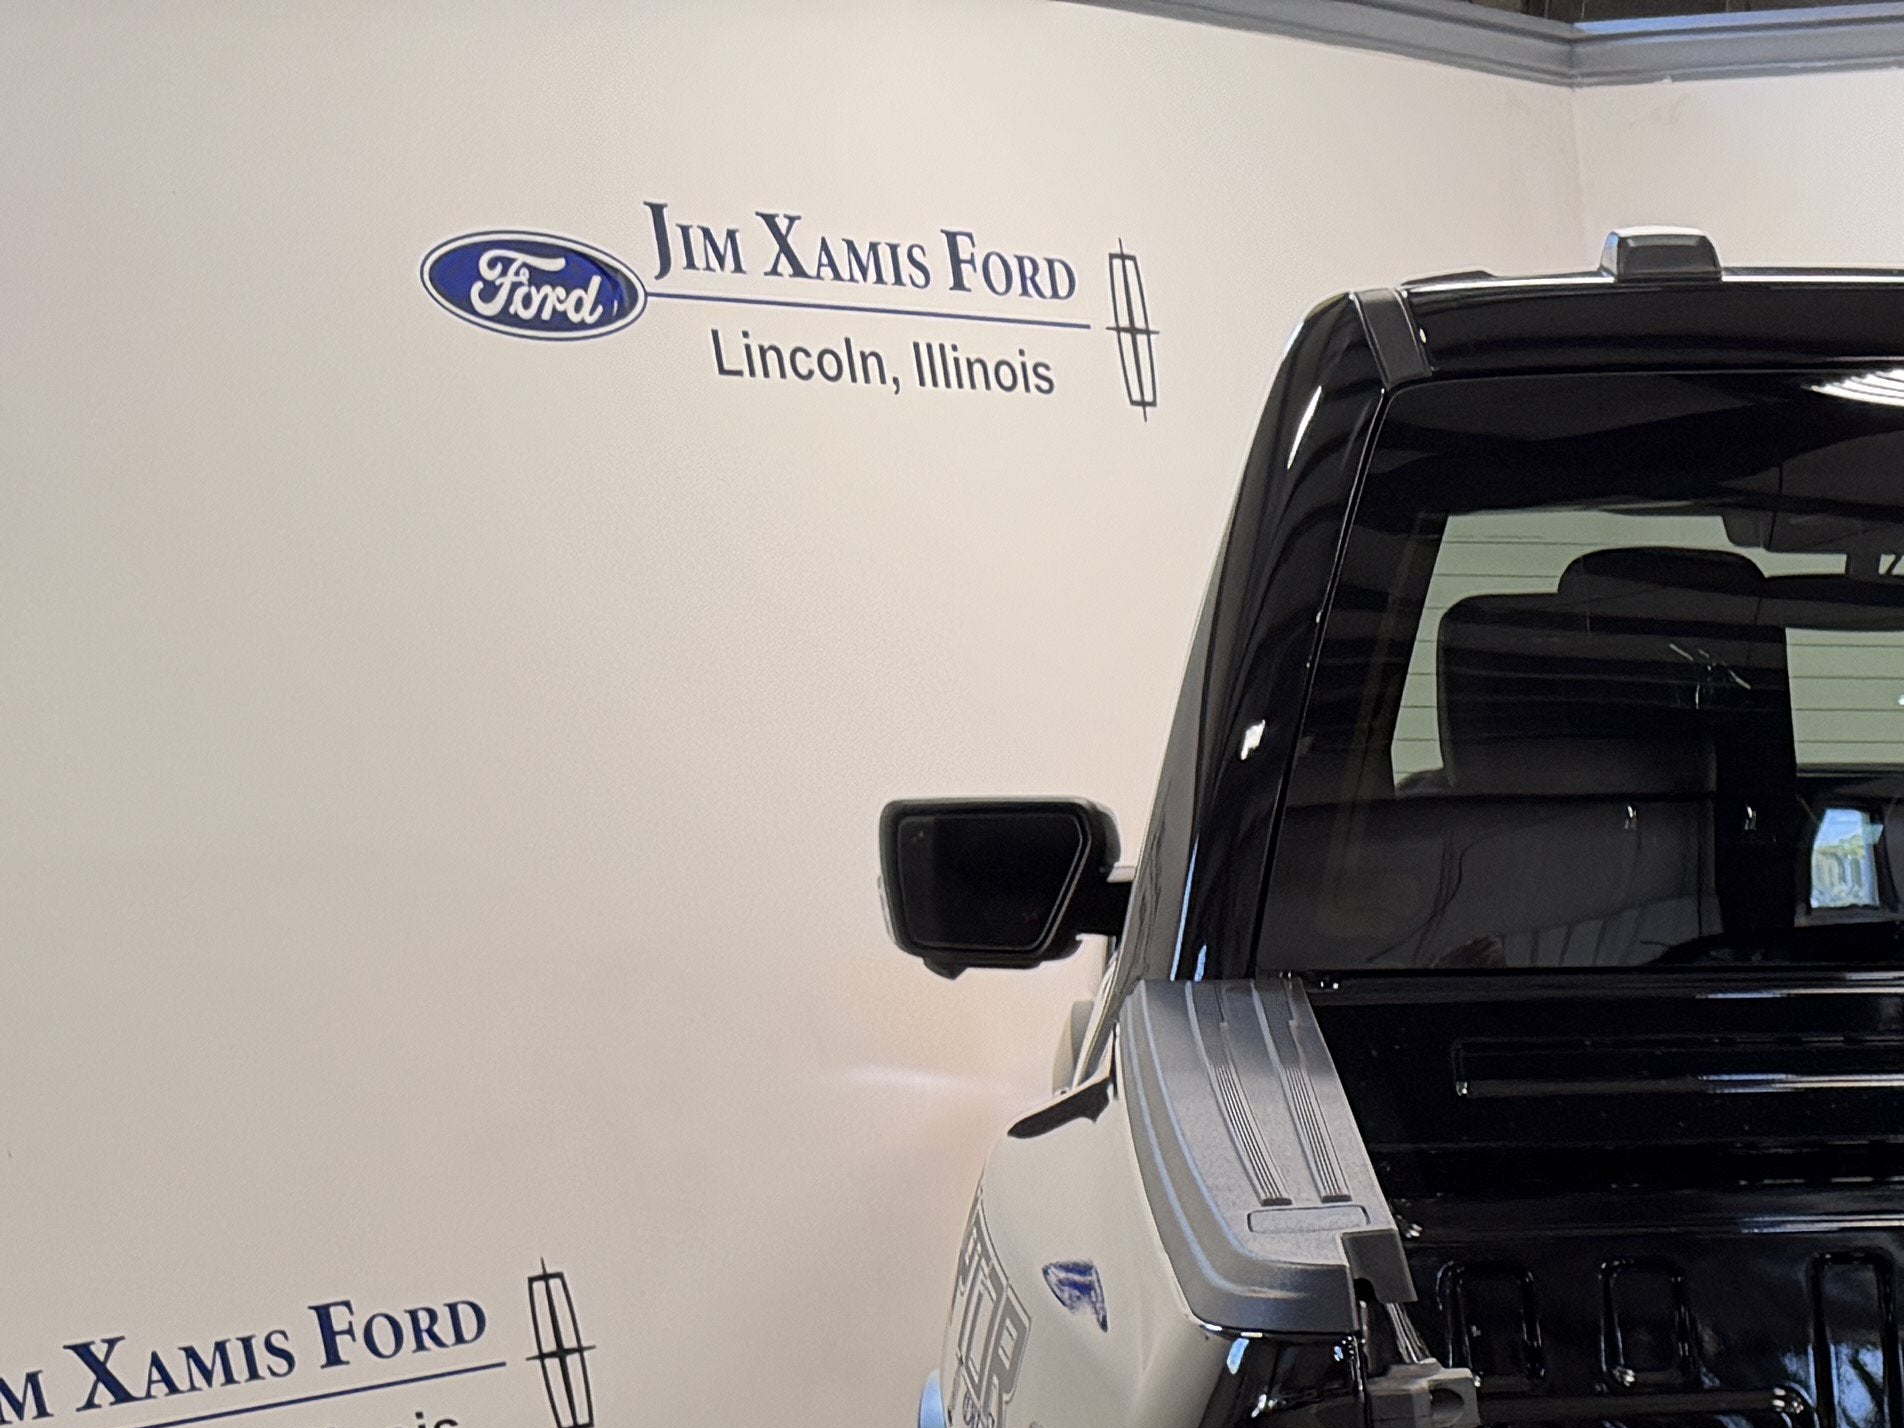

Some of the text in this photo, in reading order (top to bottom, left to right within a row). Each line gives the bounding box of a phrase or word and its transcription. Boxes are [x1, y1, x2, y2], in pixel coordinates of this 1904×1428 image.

[469, 248, 605, 326] Ford
[642, 200, 1076, 301] JIM XAMIS FORD
[710, 328, 1055, 396] Lincoln, Illinois
[63, 1329, 296, 1412] XAMIS
[308, 1299, 487, 1370] FORD
